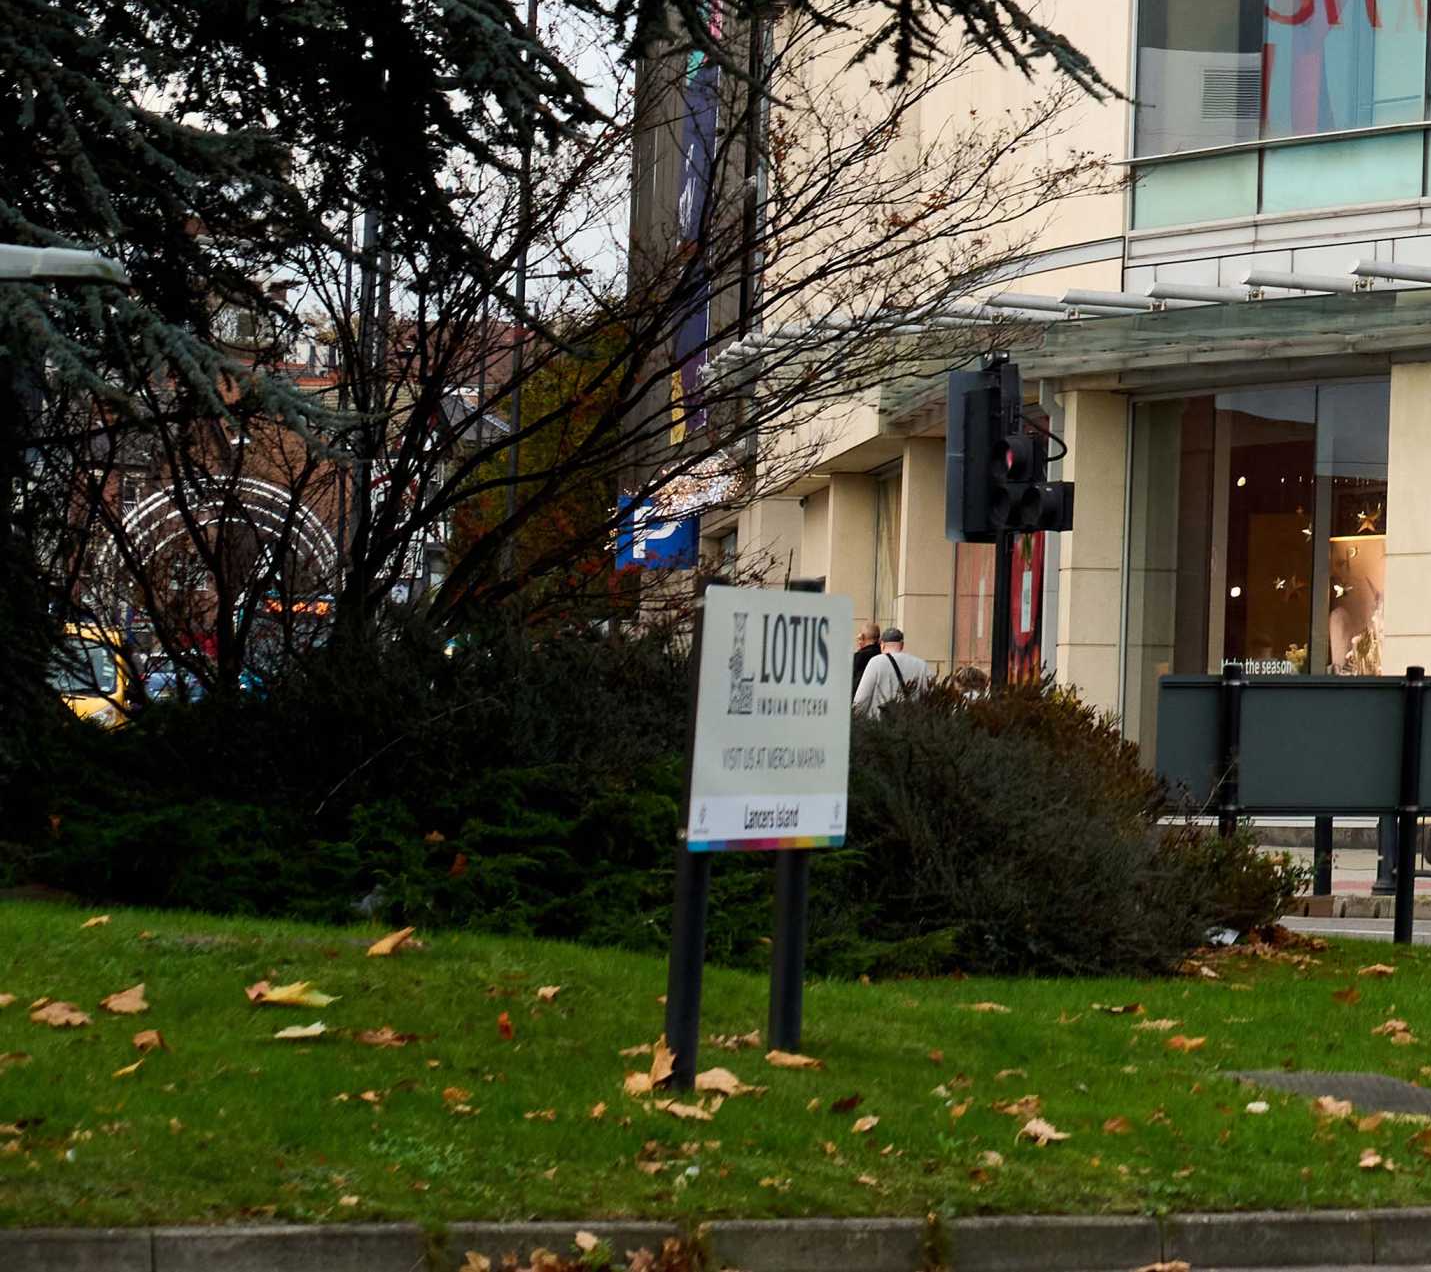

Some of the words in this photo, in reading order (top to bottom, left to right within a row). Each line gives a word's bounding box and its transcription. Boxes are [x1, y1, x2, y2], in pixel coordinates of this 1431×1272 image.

[760, 613, 830, 686] LOTUS
[1245, 657, 1260, 675] the
[1261, 661, 1292, 675] season
[744, 803, 774, 829] Lancers
[775, 802, 800, 829] Island
